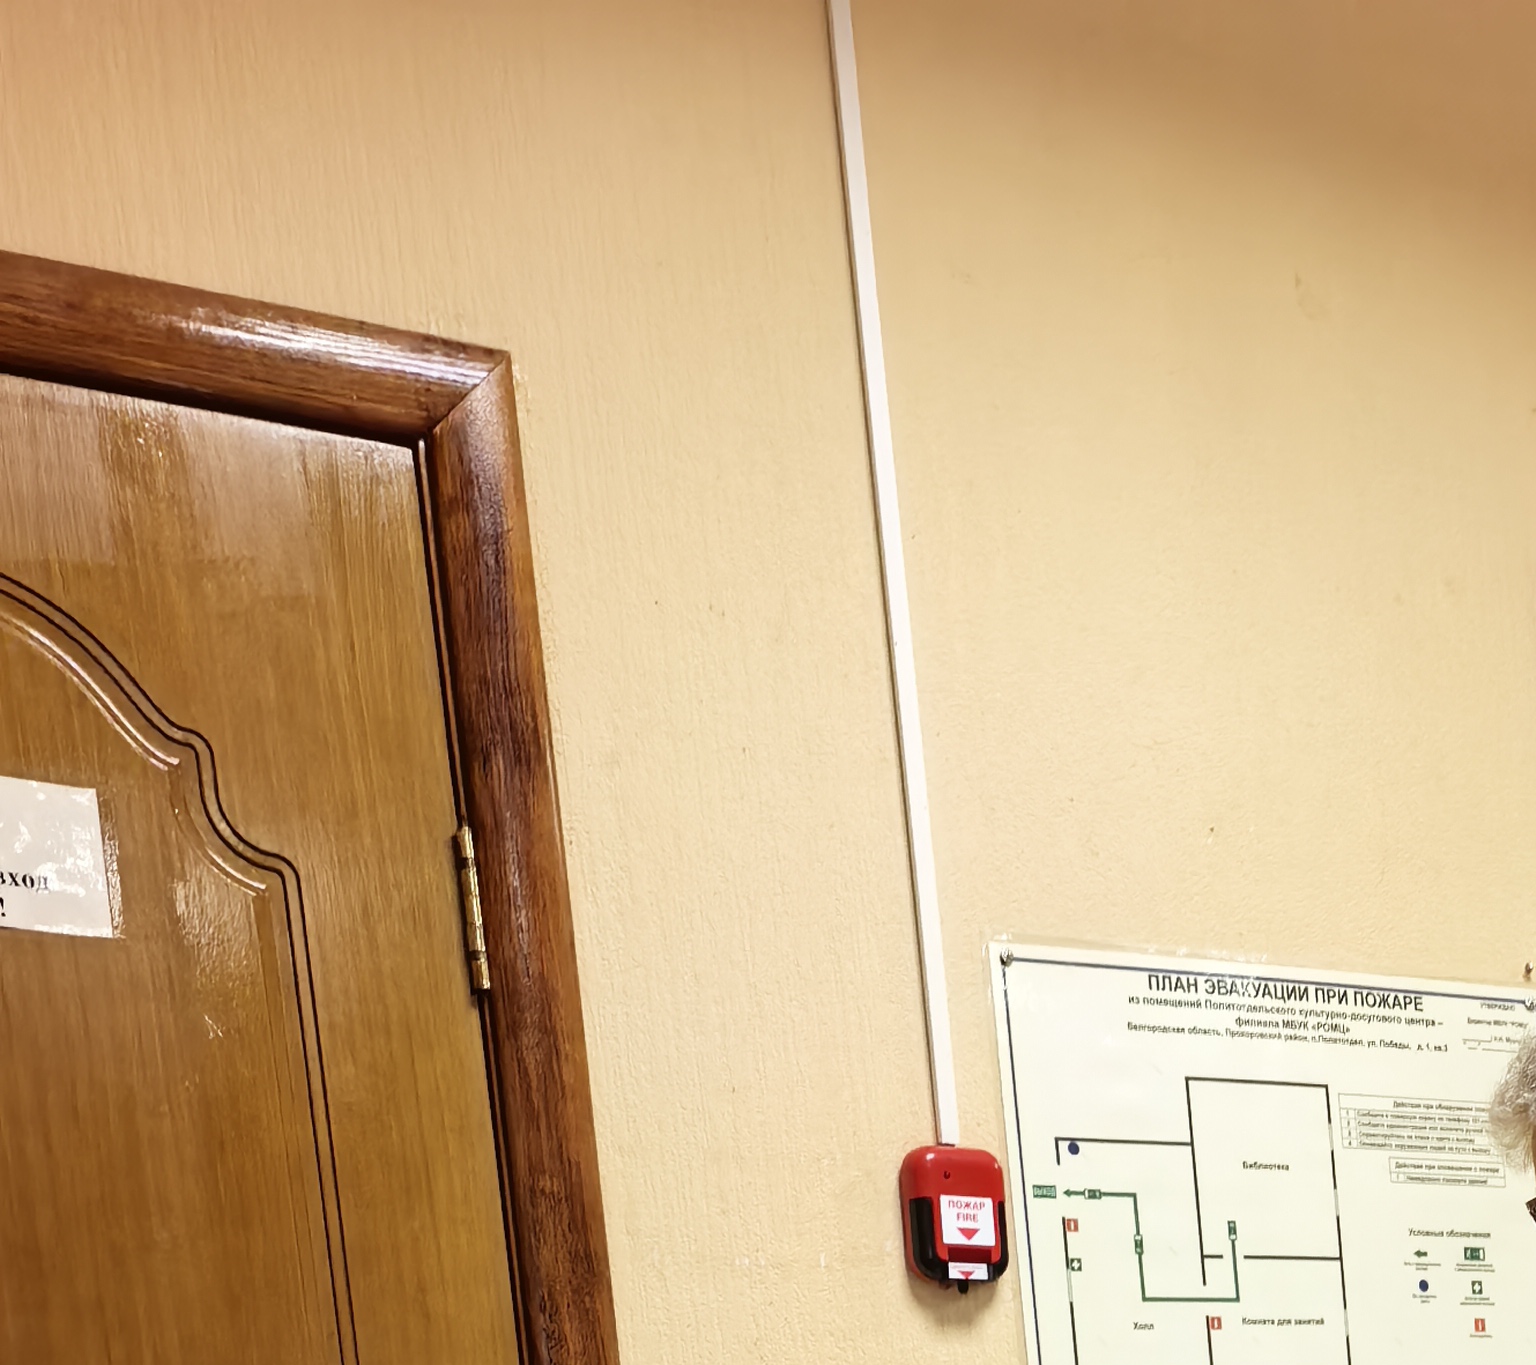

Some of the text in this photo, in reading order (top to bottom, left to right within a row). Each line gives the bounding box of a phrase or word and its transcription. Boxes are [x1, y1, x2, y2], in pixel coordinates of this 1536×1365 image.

[1148, 974, 1424, 1012] ПЛАН ЭВАКУАЦИИ ПРИ ПОЖАРЕ
[1142, 997, 1202, 1009] помещений
[1404, 1017, 1436, 1029] центра
[1282, 1019, 1309, 1031] МБУК
[948, 1200, 985, 1211] ПОЖАР
[957, 1212, 979, 1223] FIRE
